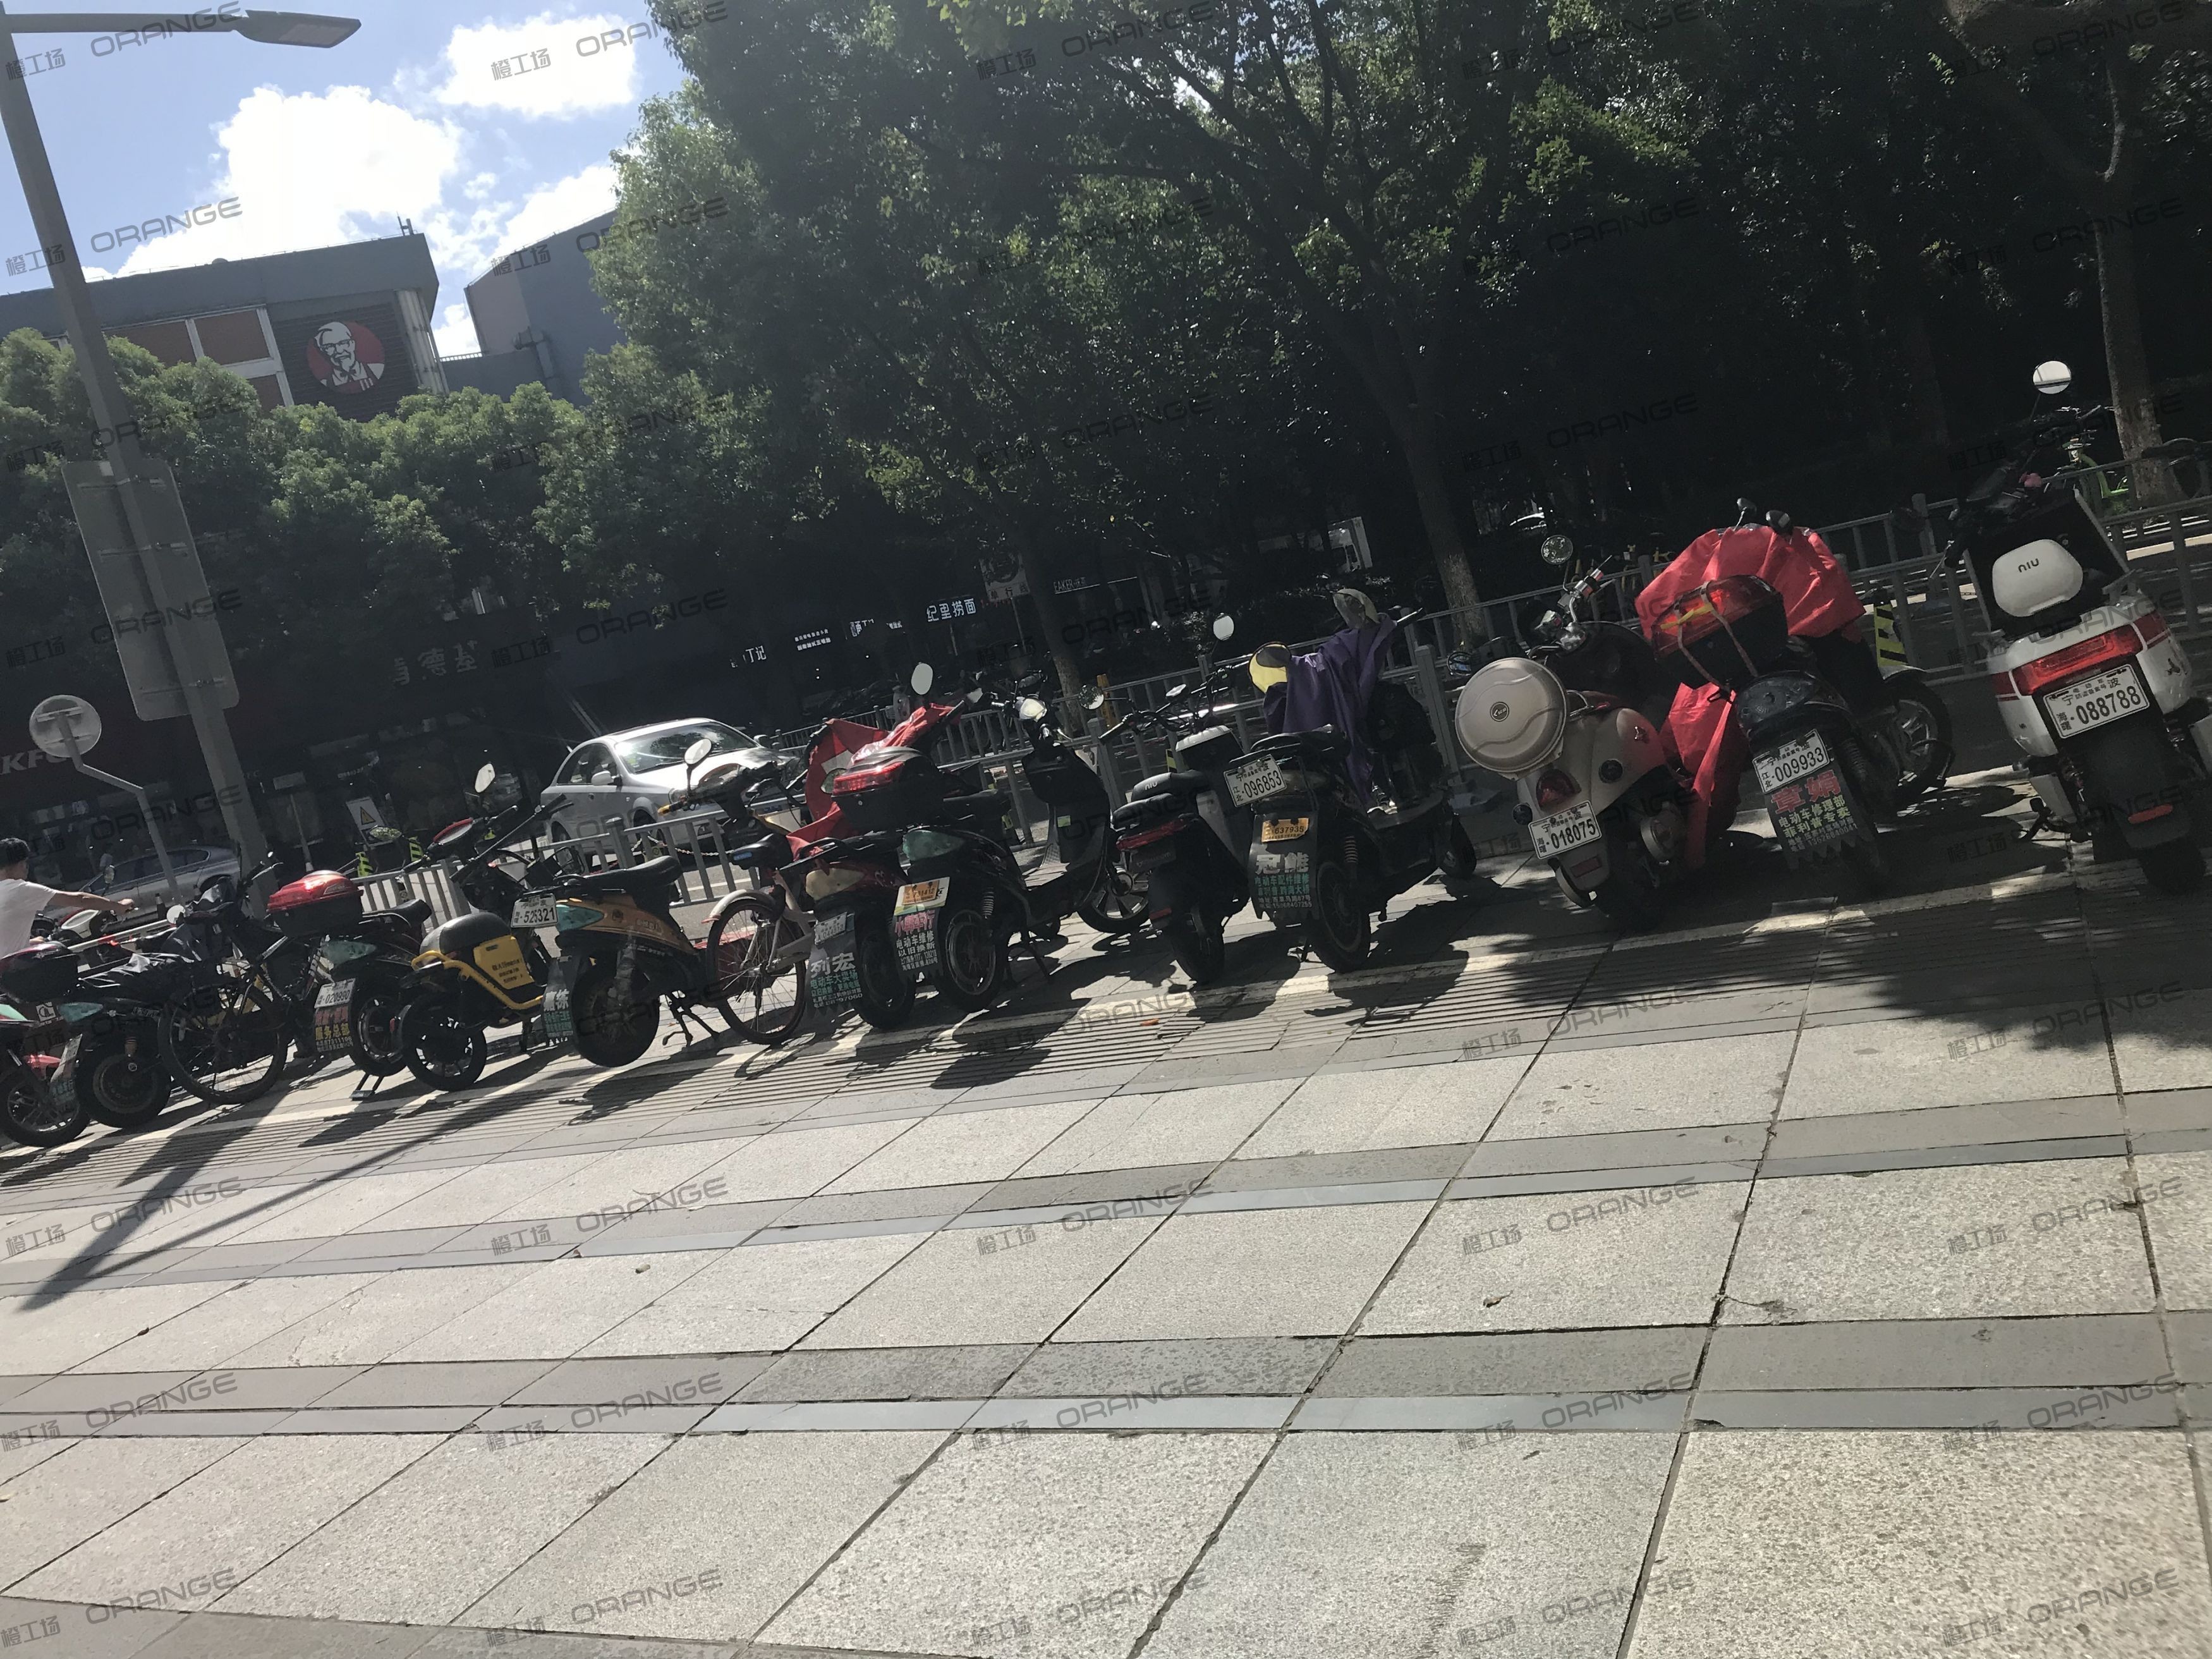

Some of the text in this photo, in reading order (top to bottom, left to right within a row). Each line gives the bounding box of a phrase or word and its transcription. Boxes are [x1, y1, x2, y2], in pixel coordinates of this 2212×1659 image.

[2075, 685, 2142, 725] 088788
[1775, 747, 1825, 782] 009933
[1243, 770, 1283, 798] 096853
[1550, 818, 1596, 849] 018075
[898, 943, 935, 957] 以旧换新
[810, 952, 856, 979] 列宏
